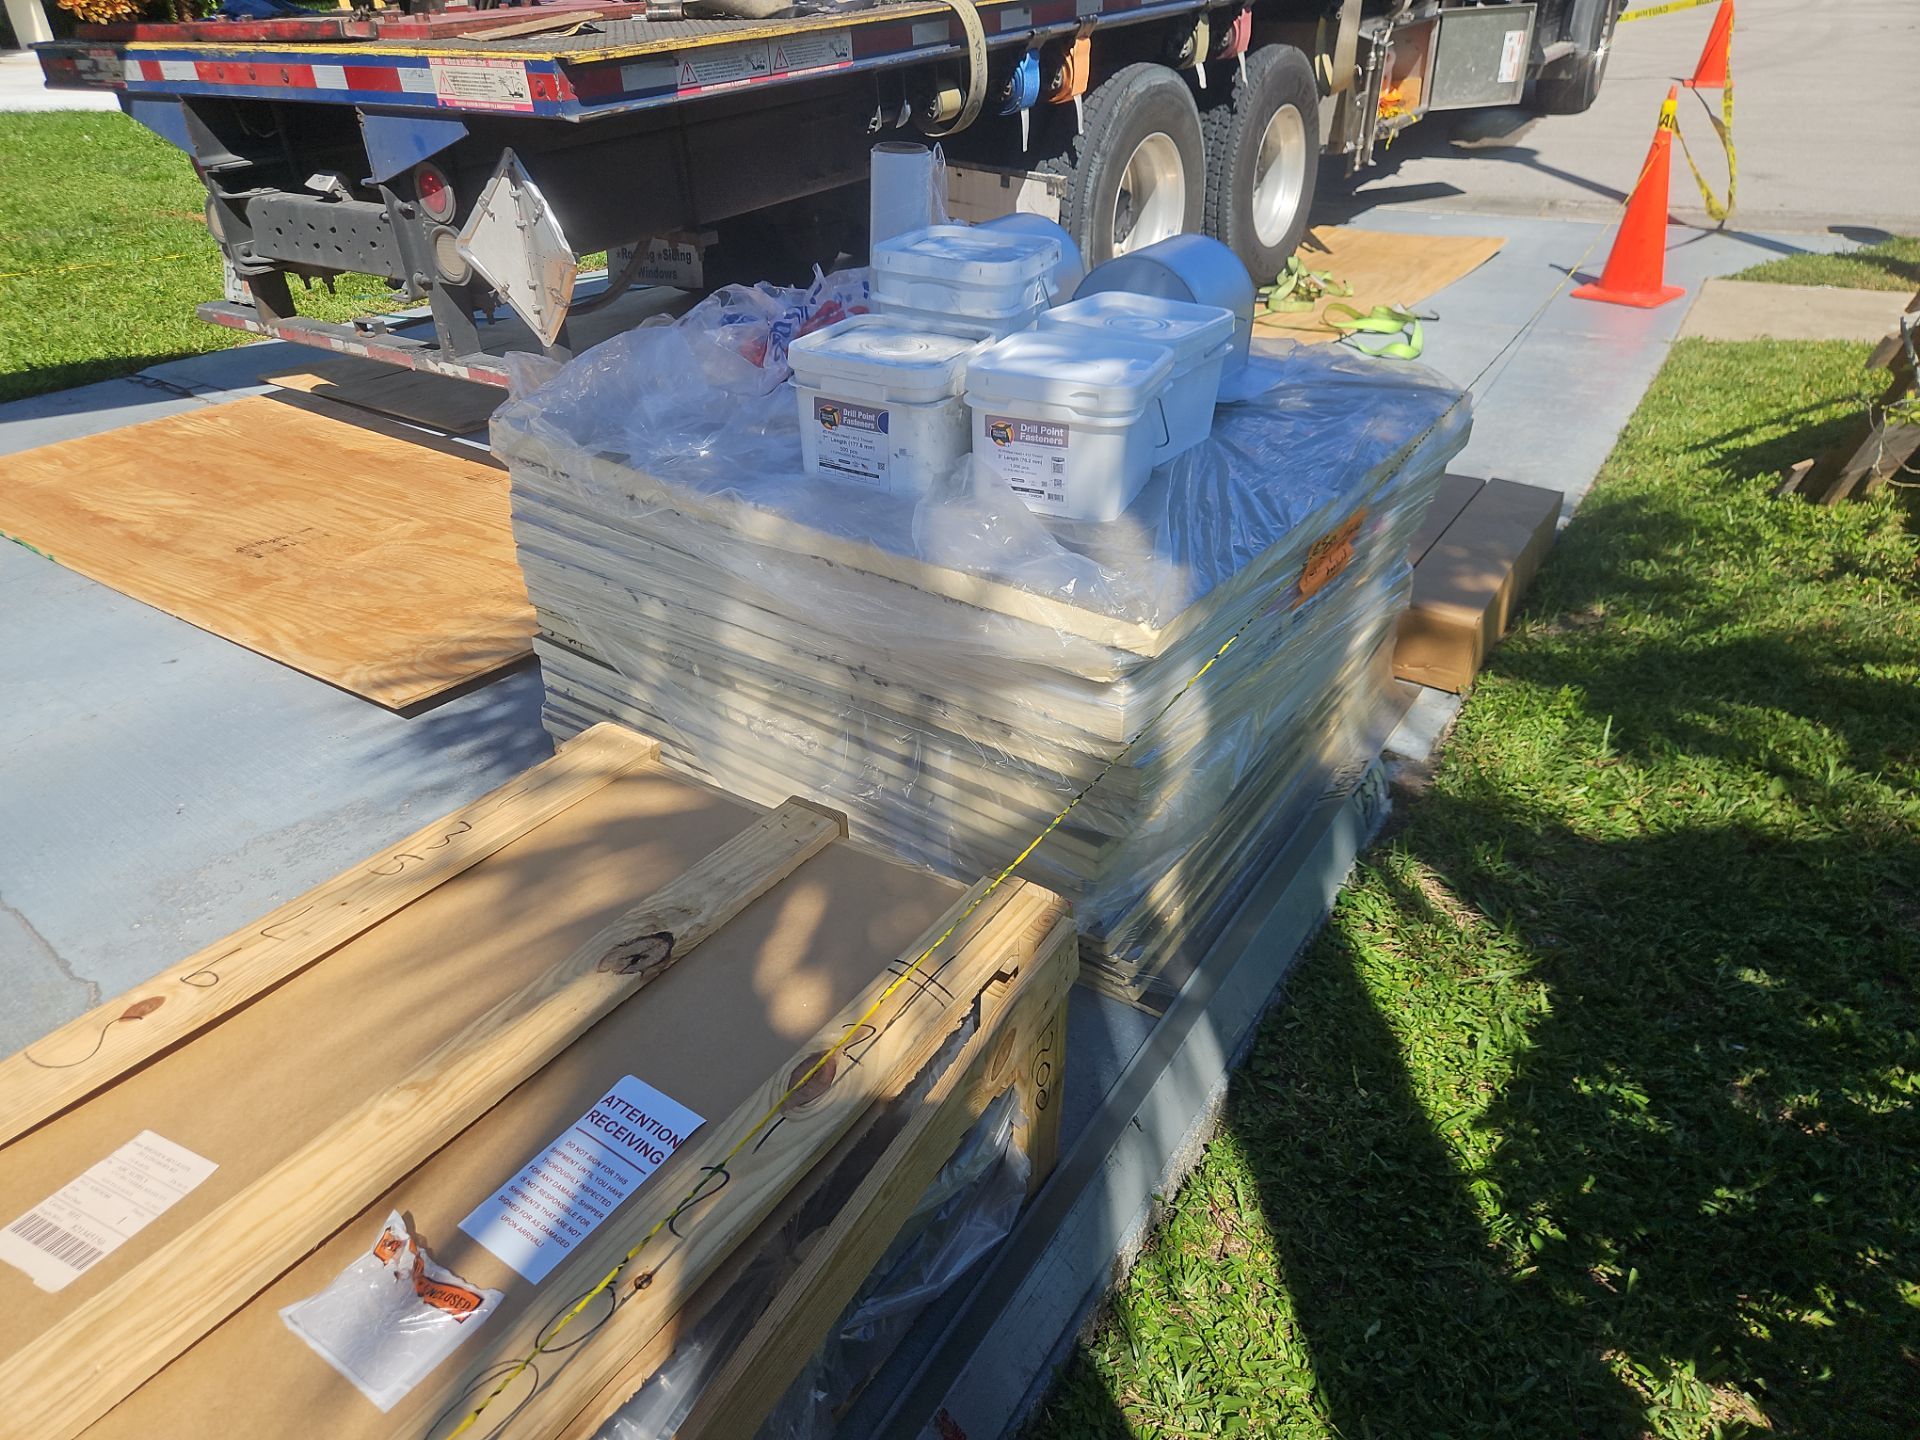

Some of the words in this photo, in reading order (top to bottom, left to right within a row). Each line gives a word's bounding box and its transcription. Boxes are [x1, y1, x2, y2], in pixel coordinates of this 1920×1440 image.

[843, 408, 857, 418] Drill
[858, 411, 876, 421] Point
[843, 417, 875, 429] Fasteners
[1020, 423, 1038, 434] Drill
[1040, 425, 1064, 437] Point
[1020, 432, 1063, 445] Fasteners
[584, 1110, 667, 1165] RECEIVING
[601, 1095, 684, 1148] ATTENTION
[541, 1158, 580, 1185] THOROUGHLY
[578, 1183, 612, 1206] INSPECTED
[550, 1148, 578, 1167] SHIPMENT
[577, 1166, 595, 1179] UNTIL
[594, 1177, 608, 1187] YOU
[606, 1185, 624, 1198] HAVE
[573, 1147, 587, 1157] NOT
[586, 1156, 602, 1167] SIGN
[600, 1165, 614, 1175] FOR
[612, 1173, 628, 1184] THIS
[507, 1185, 541, 1209] SHIPMENTS
[539, 1208, 556, 1220] THAT
[553, 1218, 568, 1229] ARE
[566, 1227, 581, 1238] NOT
[525, 1180, 539, 1190] NOT
[537, 1189, 577, 1217] RESPONSIBLE
[576, 1216, 591, 1226] FOR
[528, 1166, 541, 1175] FOR
[539, 1174, 553, 1183] ANY
[577, 1200, 605, 1219] SHIPPER
[497, 1195, 520, 1212] SIGNED
[518, 1210, 532, 1221] FOR
[531, 1219, 541, 1227] AS
[539, 1225, 570, 1248] DAMAGED
[500, 1215, 518, 1228] UPON
[516, 1227, 544, 1247] ARRIVAL!
